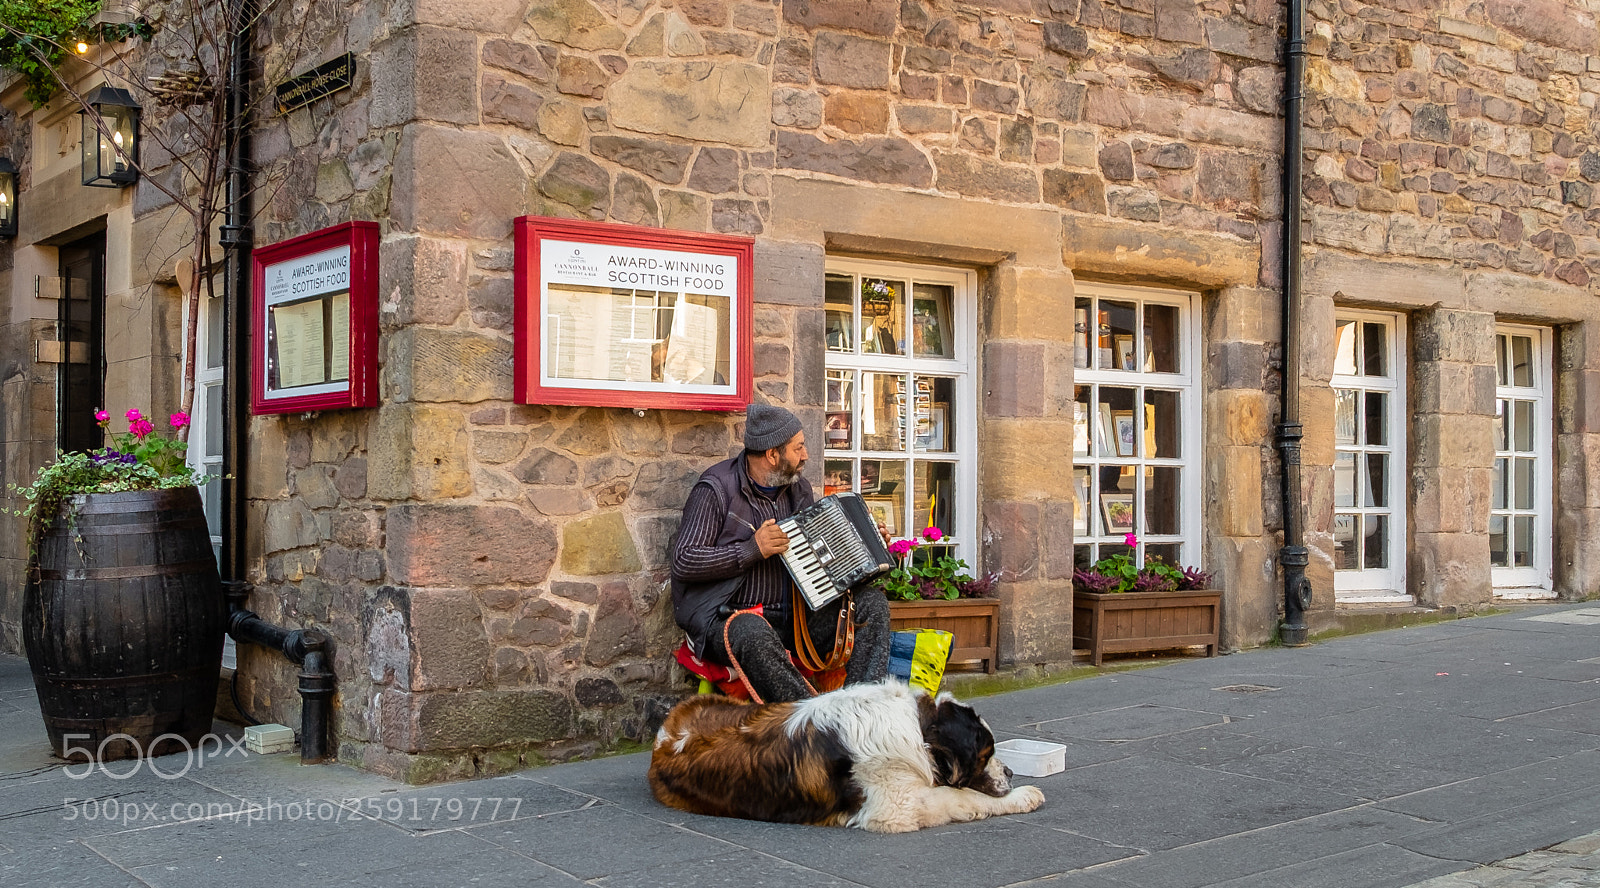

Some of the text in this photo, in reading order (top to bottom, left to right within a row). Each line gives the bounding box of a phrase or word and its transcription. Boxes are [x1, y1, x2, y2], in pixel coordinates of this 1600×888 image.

[329, 64, 347, 81] CLOSE
[292, 255, 347, 279] AWARD-WINNING
[607, 255, 724, 275] AWARD-WINNING
[292, 277, 325, 295] SCOTTISH
[326, 271, 347, 287] FOOD
[608, 270, 724, 290] SCOTTISH FOOD
